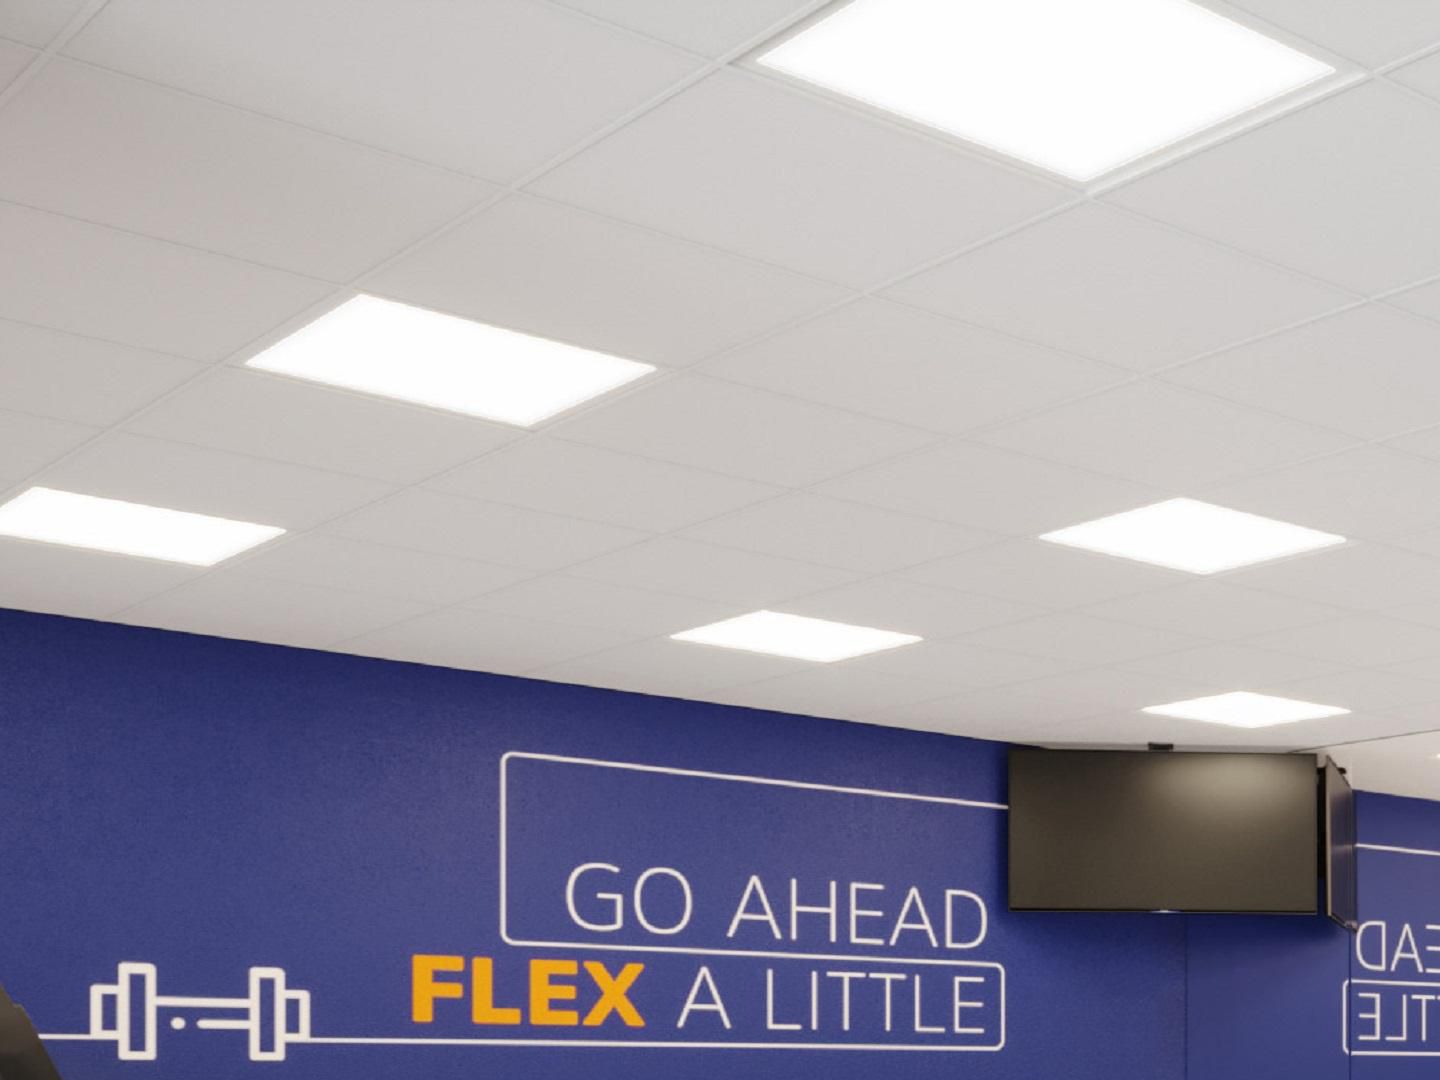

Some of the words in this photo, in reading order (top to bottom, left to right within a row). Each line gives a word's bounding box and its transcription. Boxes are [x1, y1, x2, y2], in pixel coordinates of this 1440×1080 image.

[565, 862, 693, 935] GO
[726, 874, 988, 950] AHEAD
[411, 953, 646, 1028] FLEX
[676, 965, 732, 1030] A
[766, 968, 985, 1034] LITTLE
